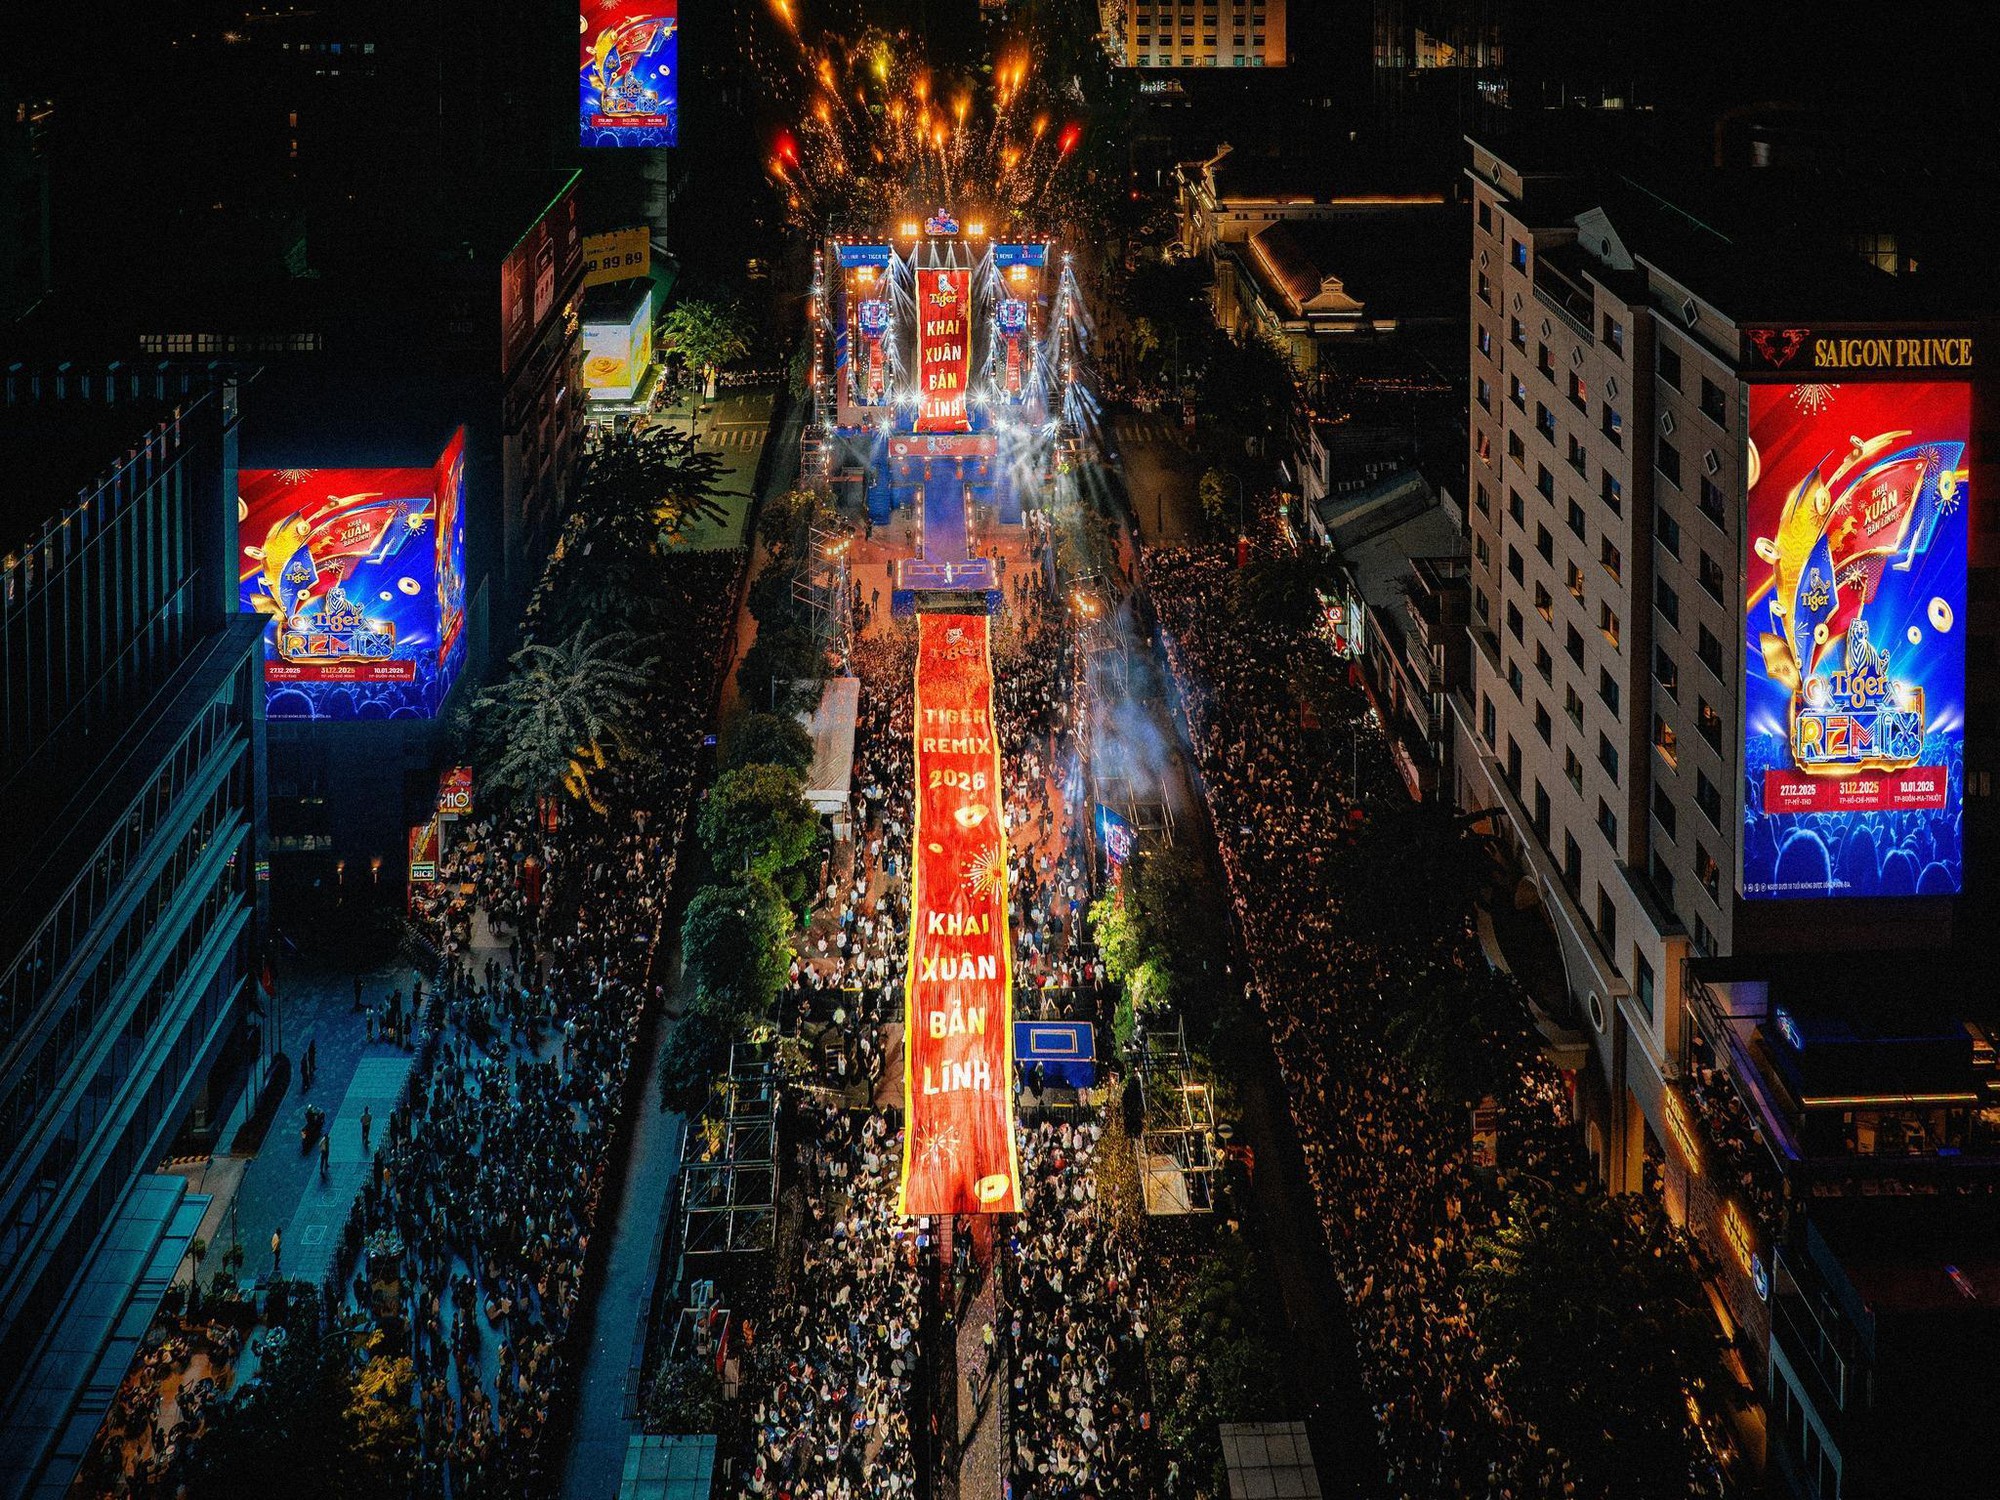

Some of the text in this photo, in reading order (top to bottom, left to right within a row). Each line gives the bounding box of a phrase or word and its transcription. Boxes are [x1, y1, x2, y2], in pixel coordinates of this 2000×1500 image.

[929, 293, 957, 307] Tiger
[927, 319, 959, 337] KHAI
[925, 343, 962, 364] XUÂN
[1814, 338, 1973, 368] SAIGON PRINCE
[929, 369, 957, 391] BẢN
[926, 398, 961, 418] LĨNH
[1871, 481, 1888, 500] KHAI
[1863, 489, 1898, 528] XUÂN
[341, 522, 371, 542] XUÂN
[285, 573, 311, 584] Tiger
[1801, 591, 1830, 612] Tiger
[315, 612, 361, 632] Tiger
[283, 632, 394, 656] REMIX
[1831, 667, 1889, 709] Tiger
[923, 708, 986, 725] TIGER
[922, 737, 992, 755] REMIX
[1796, 712, 1922, 759] REMIX
[928, 769, 986, 792] 2026
[1780, 781, 1935, 796] 27.12.2025 31.12.2025 10.01.2026
[928, 910, 990, 936] KHAI
[921, 952, 998, 982] XUÂN
[929, 1000, 985, 1040] BẢN
[923, 1059, 991, 1096] LĨNH
